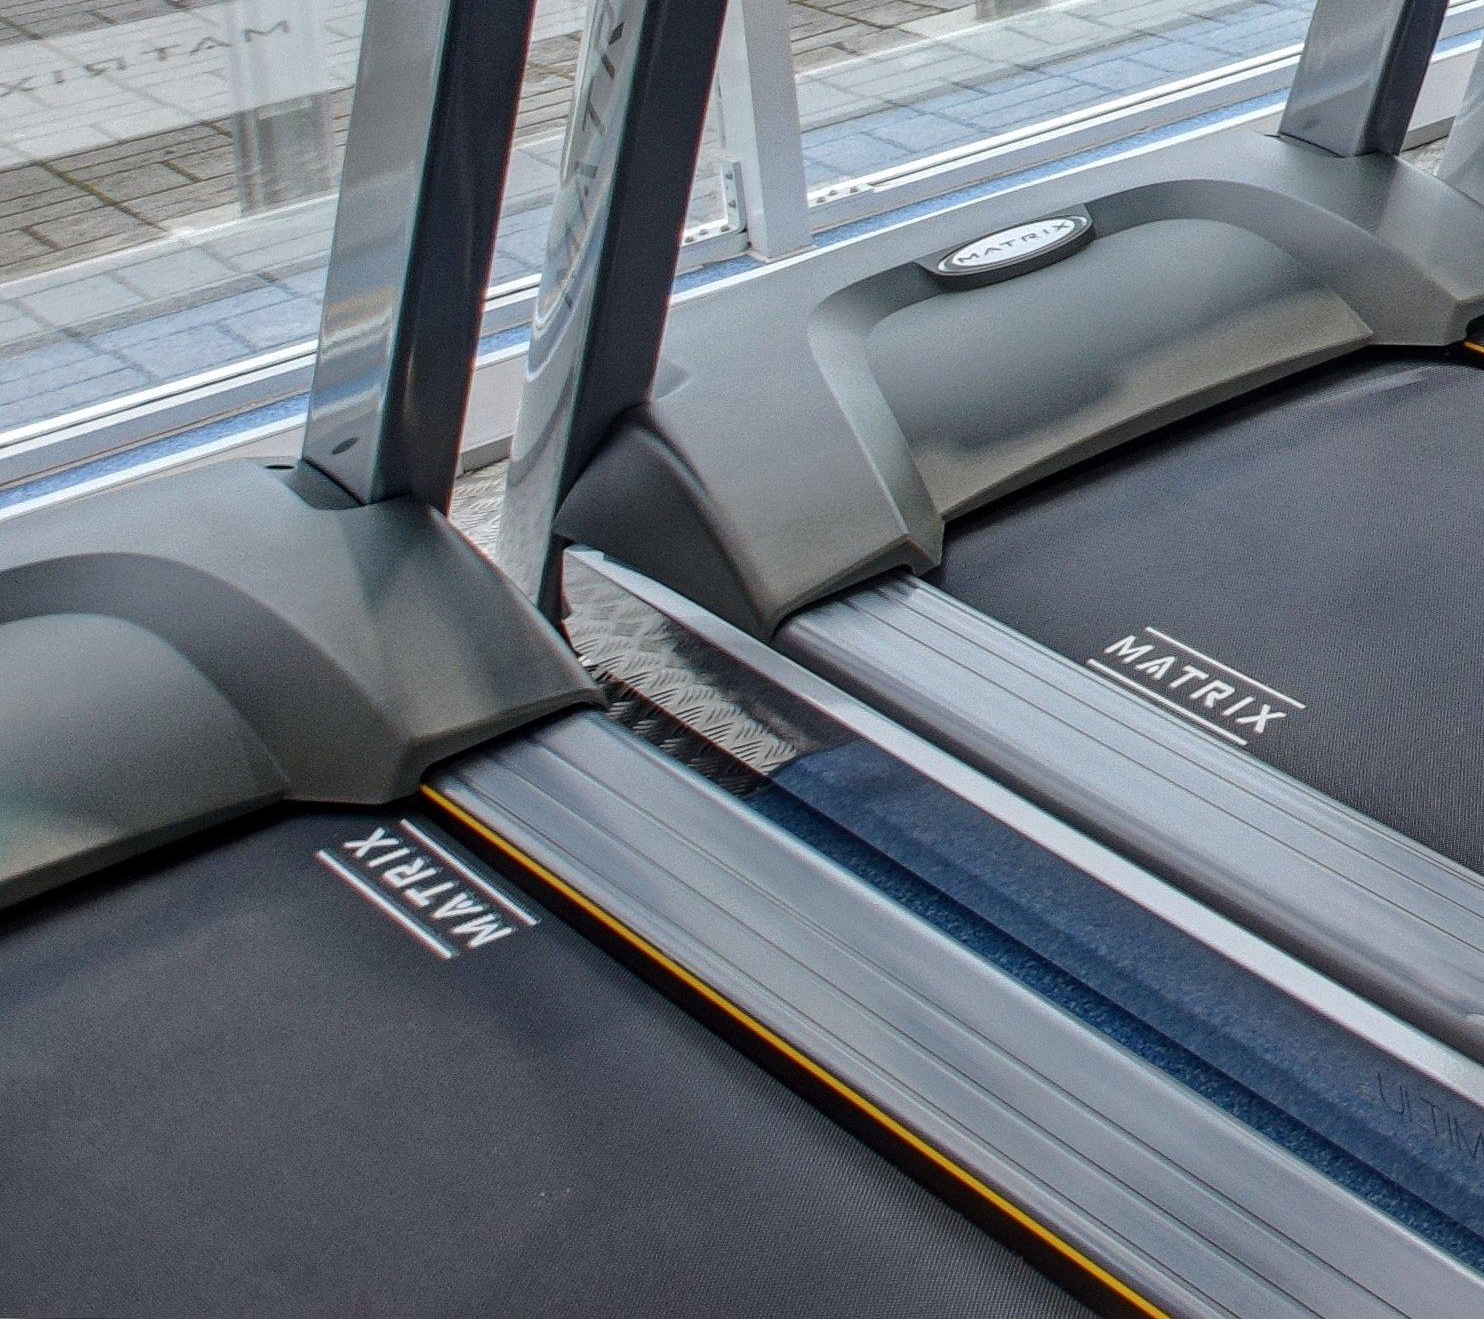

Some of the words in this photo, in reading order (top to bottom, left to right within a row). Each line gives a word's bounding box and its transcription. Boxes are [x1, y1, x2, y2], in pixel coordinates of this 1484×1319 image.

[957, 221, 1070, 264] MATRIX
[1103, 633, 1288, 736] MATRIX
[343, 825, 518, 950] MATRIX
